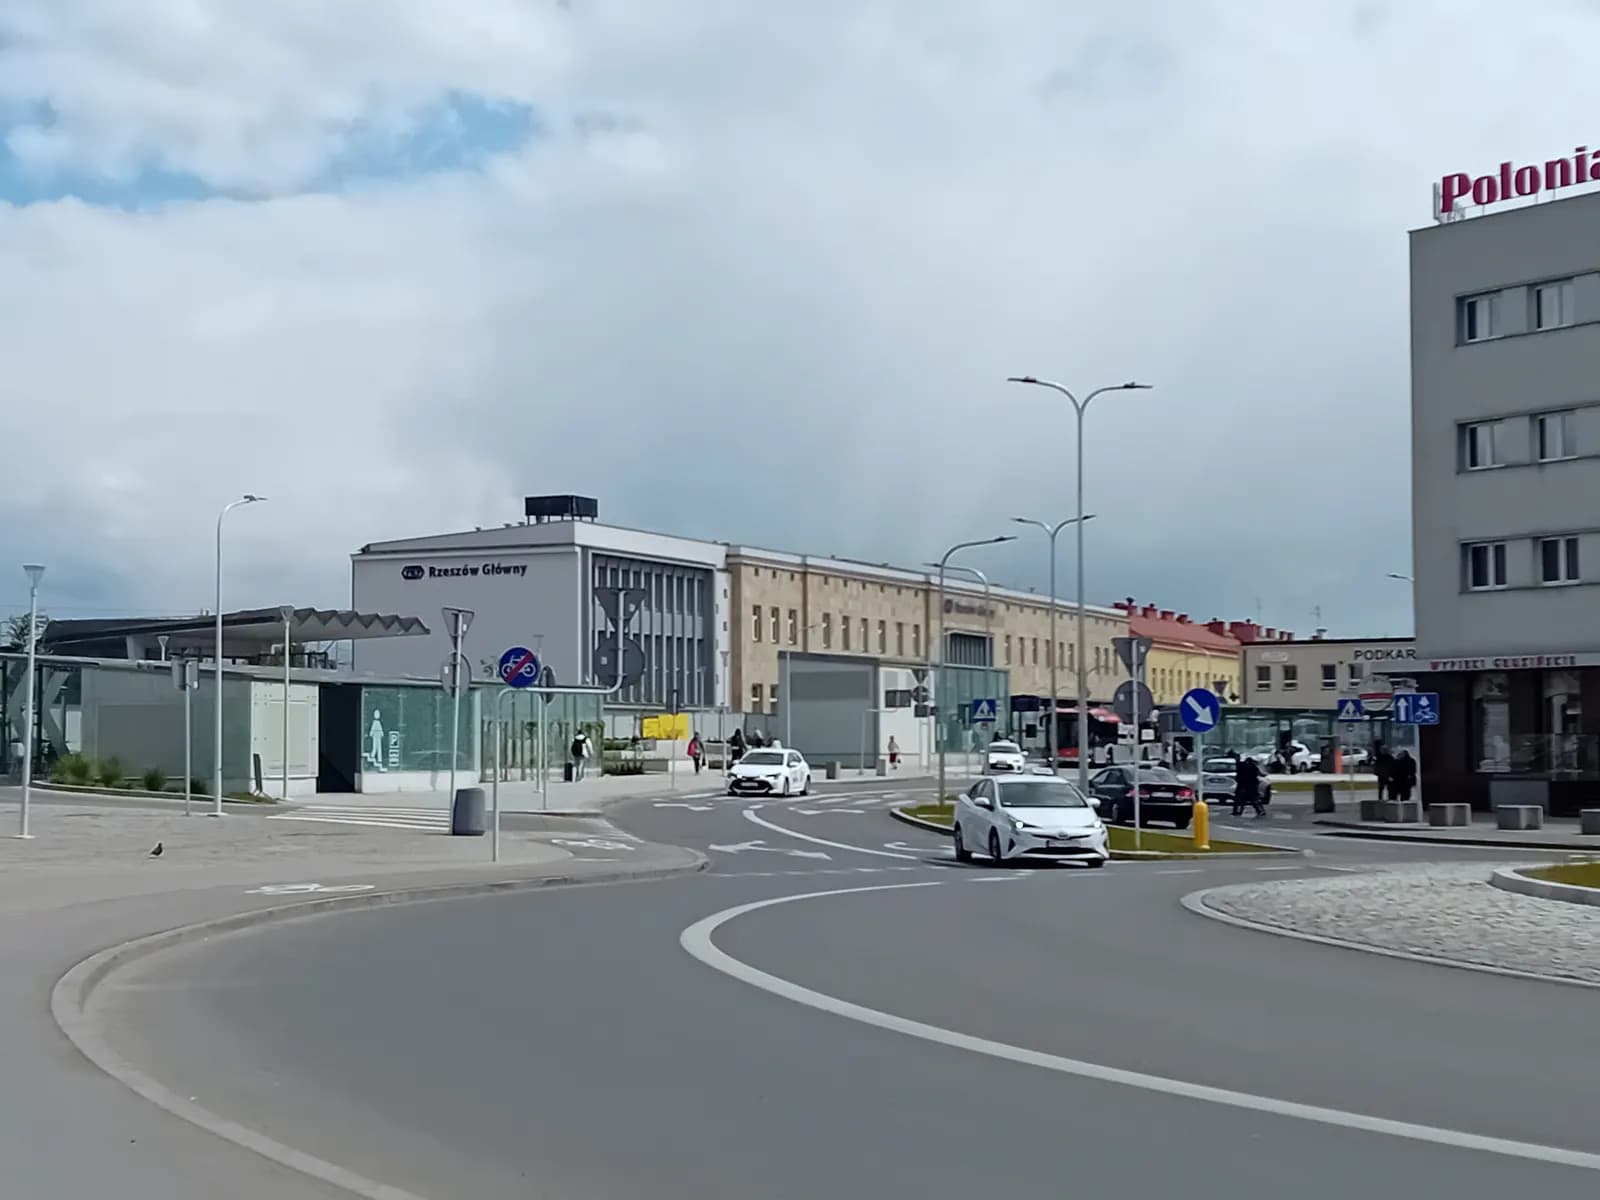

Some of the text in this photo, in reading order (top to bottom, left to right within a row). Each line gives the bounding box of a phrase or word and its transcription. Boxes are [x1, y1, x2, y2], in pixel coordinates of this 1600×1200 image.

[428, 565, 479, 578] Rzeszów
[482, 562, 527, 577] Główny
[1354, 649, 1416, 660] PODKAR
